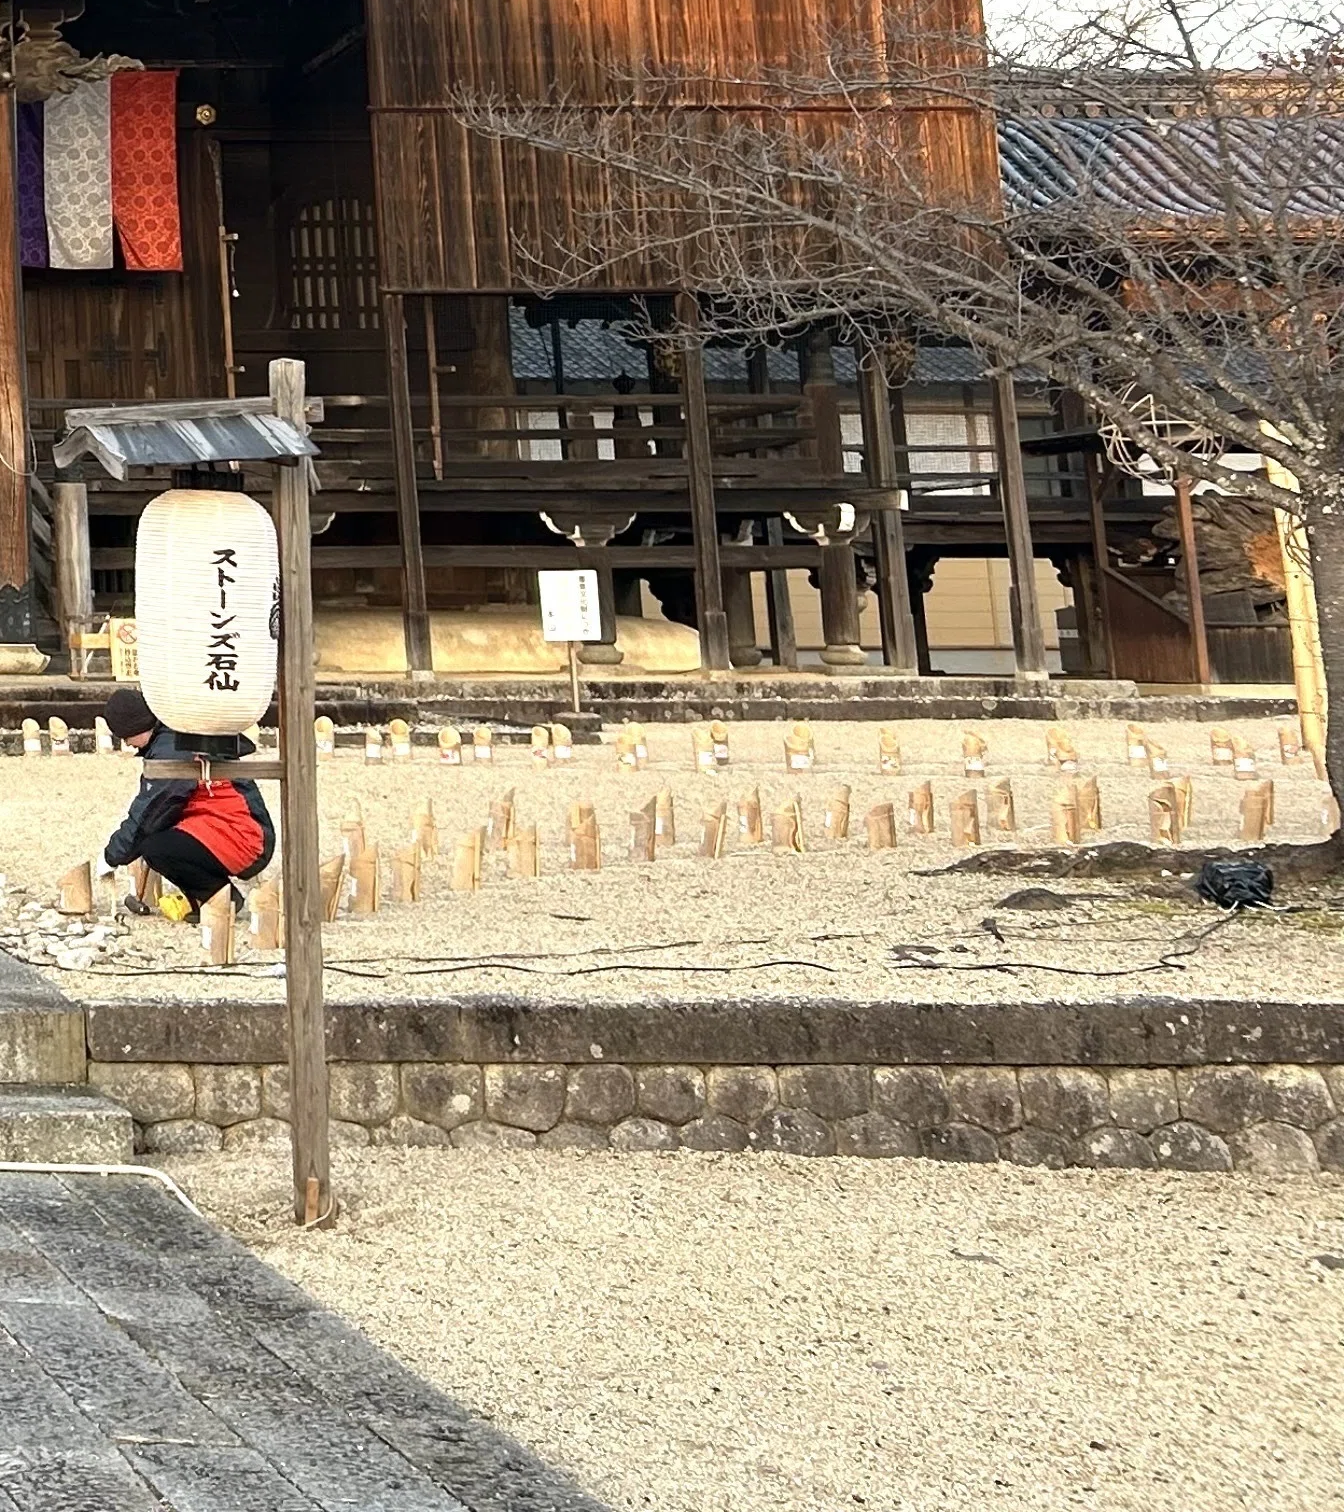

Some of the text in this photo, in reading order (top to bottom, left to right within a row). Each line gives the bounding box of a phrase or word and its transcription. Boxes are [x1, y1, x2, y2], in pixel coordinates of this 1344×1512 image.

[202, 548, 242, 693] ストーンズ石仙
